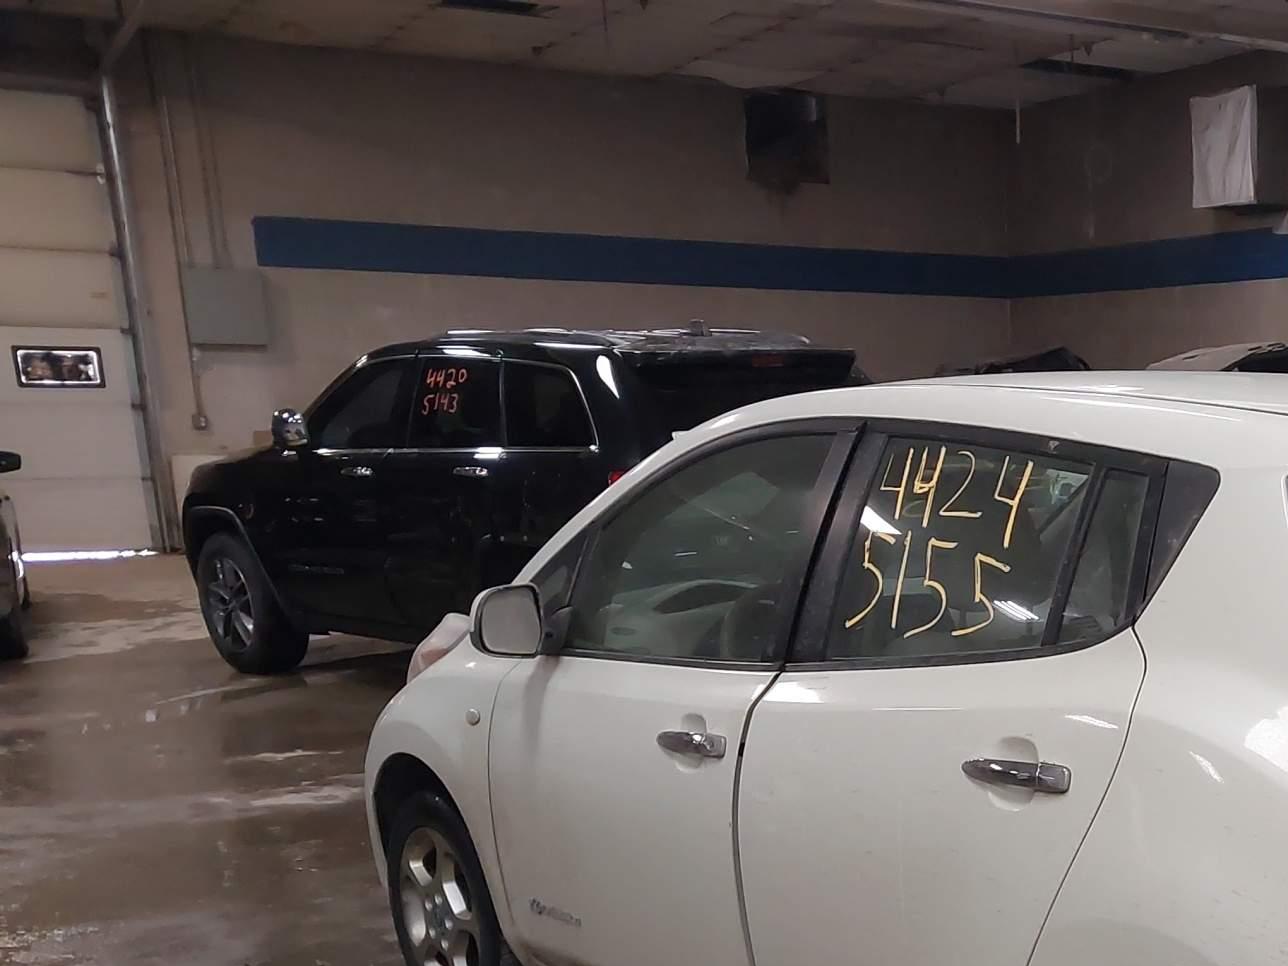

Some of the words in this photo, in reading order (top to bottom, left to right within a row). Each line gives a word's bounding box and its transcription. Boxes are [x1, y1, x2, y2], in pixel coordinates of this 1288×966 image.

[421, 393, 459, 415] 5143
[426, 368, 468, 389] 4420
[879, 445, 1035, 549] 4424
[844, 530, 1012, 639] 5155
